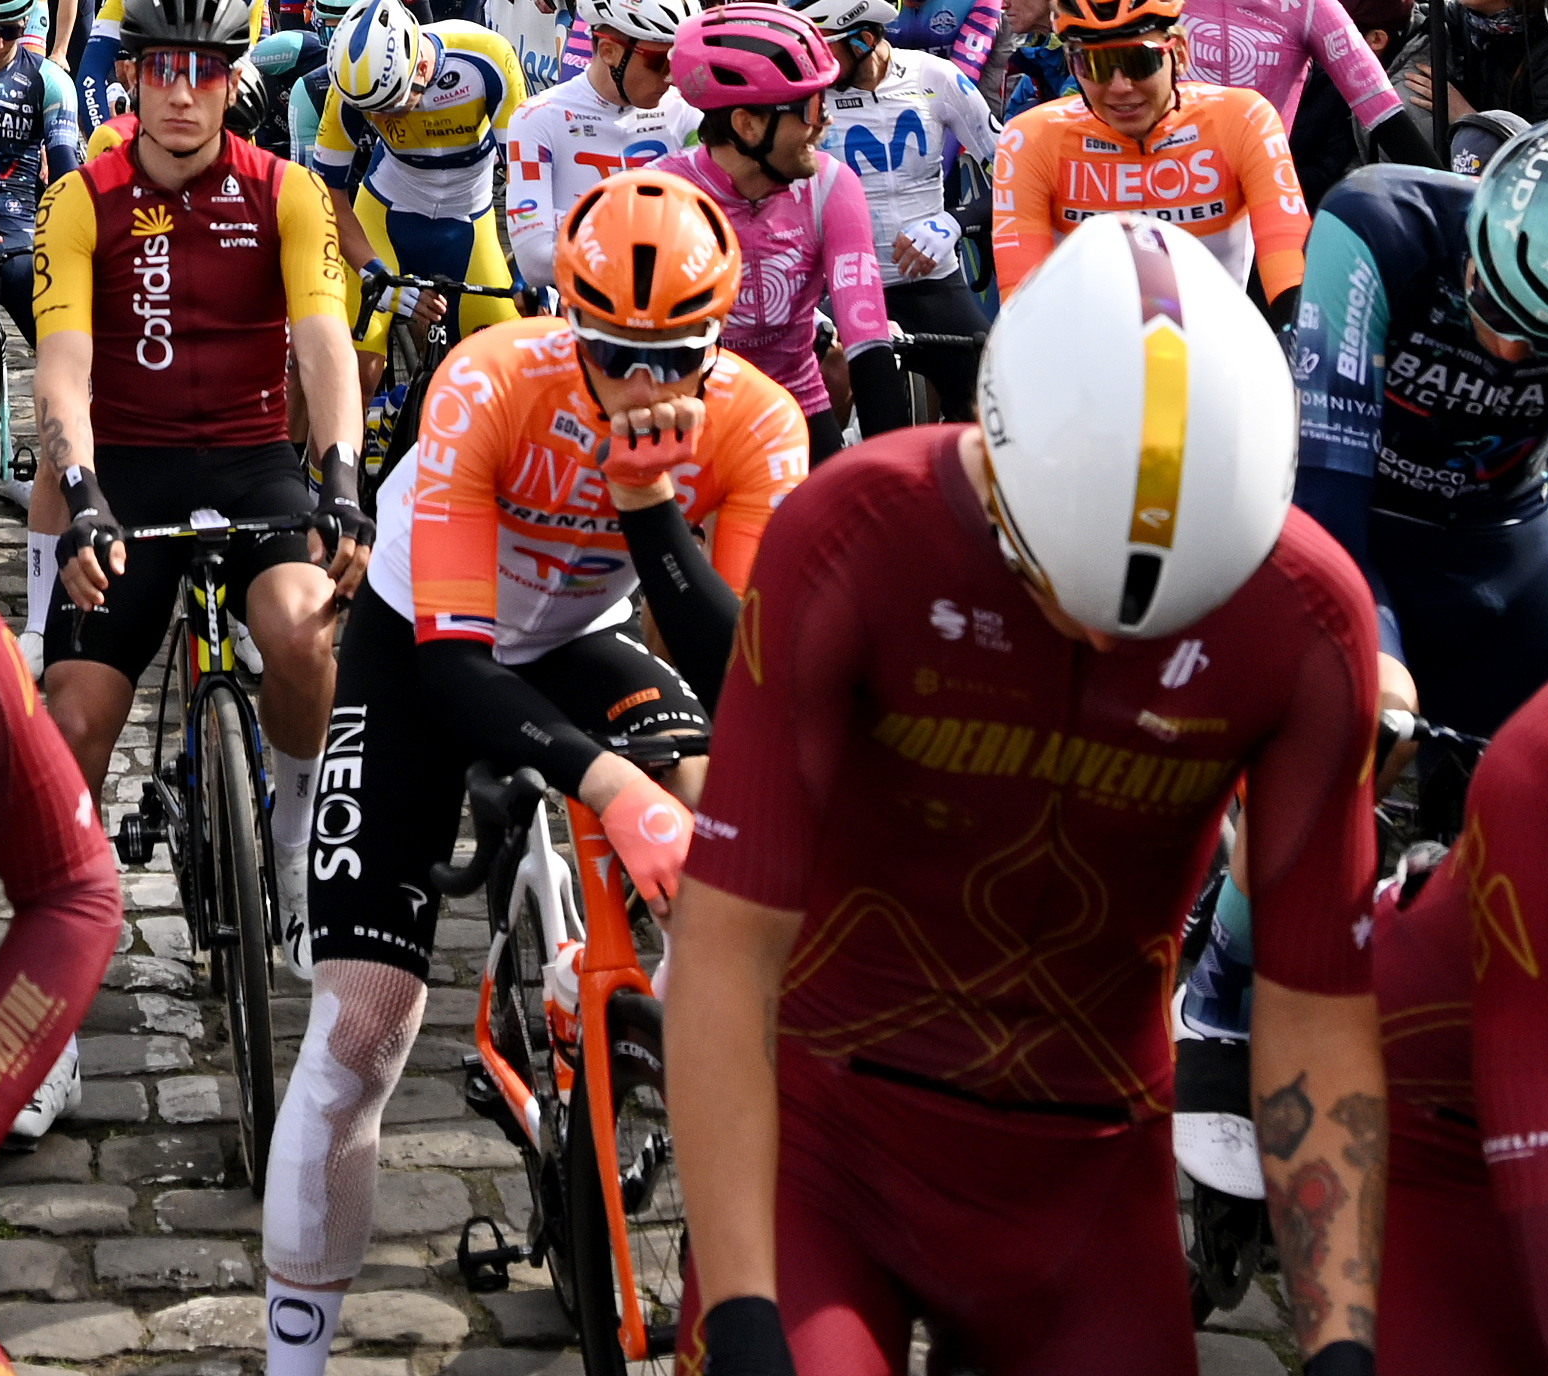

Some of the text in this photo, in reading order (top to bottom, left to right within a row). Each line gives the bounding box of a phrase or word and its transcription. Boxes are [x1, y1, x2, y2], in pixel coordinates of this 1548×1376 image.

[839, 5, 867, 24] ABUS
[381, 24, 397, 87] RUDY
[422, 117, 452, 128] Team
[433, 85, 471, 104] CALLANT
[1069, 149, 1220, 203] INEOS
[1245, 97, 1308, 216] INEOS
[992, 128, 1024, 250] INEOS
[209, 221, 259, 233] LOOK
[220, 236, 259, 248] uvex
[137, 233, 174, 371] Cofidis
[1336, 258, 1375, 378] Bianchi
[413, 356, 494, 524] INEOS
[1380, 446, 1467, 486] Bapco
[210, 585, 222, 656] LOOK
[313, 702, 368, 883] INEOS
